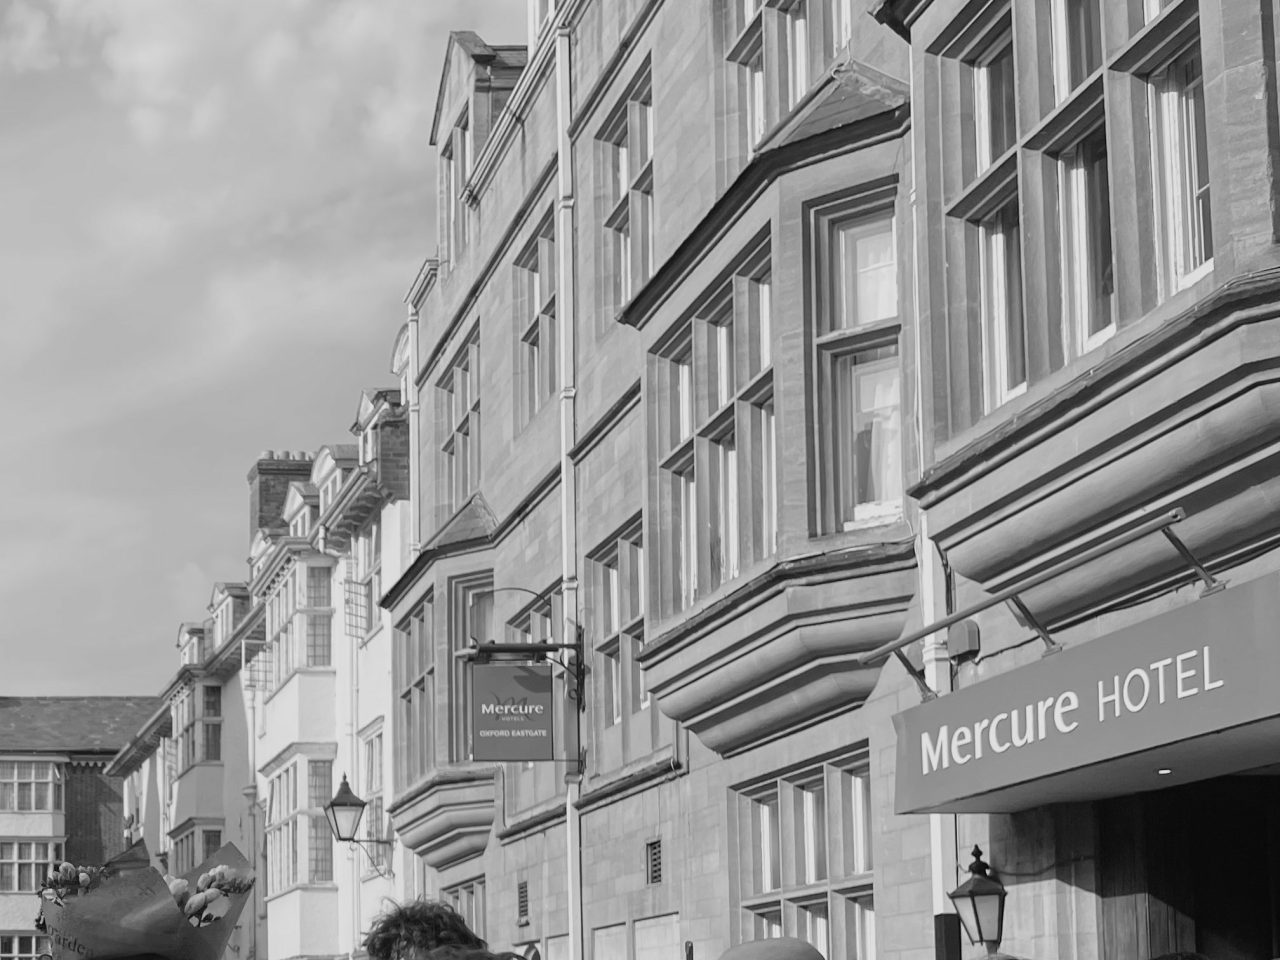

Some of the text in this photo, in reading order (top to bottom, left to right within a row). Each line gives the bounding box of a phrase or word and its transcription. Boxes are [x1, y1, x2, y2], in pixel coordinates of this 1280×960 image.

[481, 704, 543, 714] Mercure
[921, 646, 1224, 776] Mercure HOTEL
[479, 729, 547, 737] OXFORD EASTGATE
